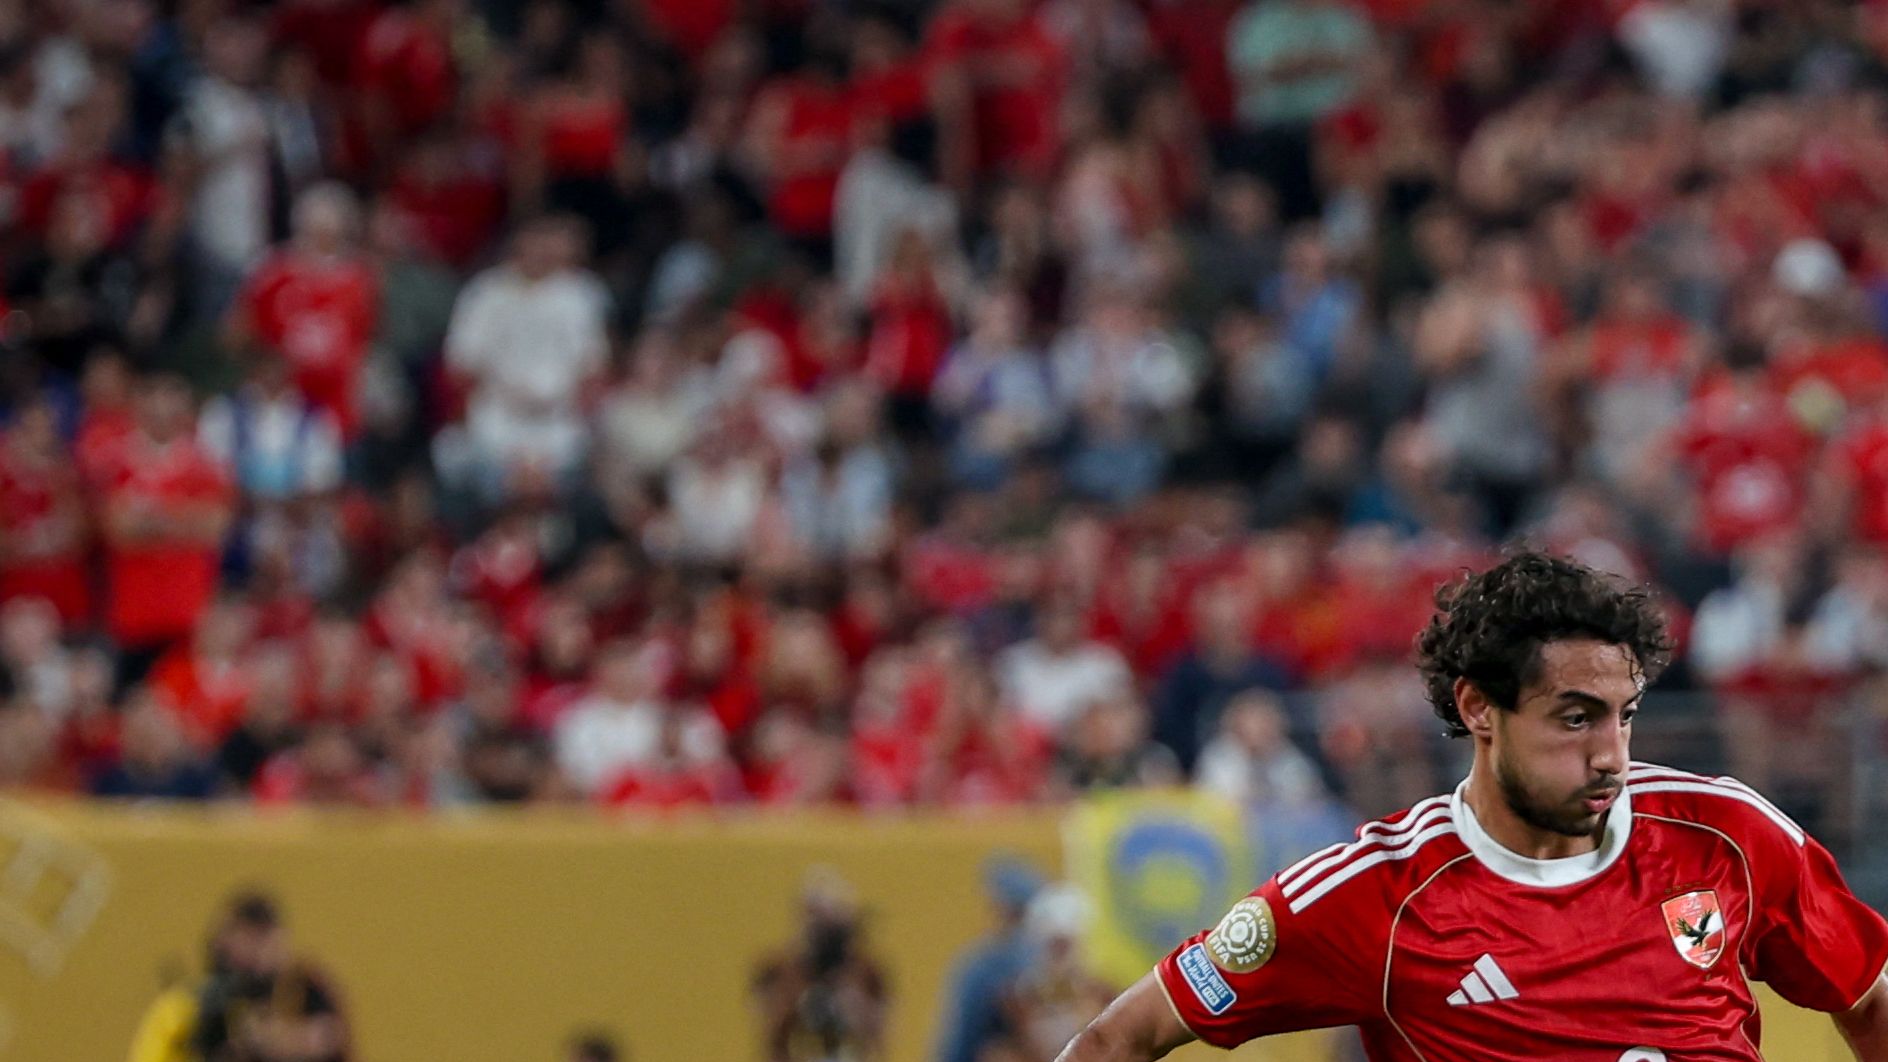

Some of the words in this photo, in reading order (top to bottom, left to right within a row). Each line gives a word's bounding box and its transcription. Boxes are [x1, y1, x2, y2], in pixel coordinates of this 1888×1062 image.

[1259, 918, 1269, 940] CUP
[1209, 935, 1230, 964] FIFA
[1236, 952, 1258, 965] USA
